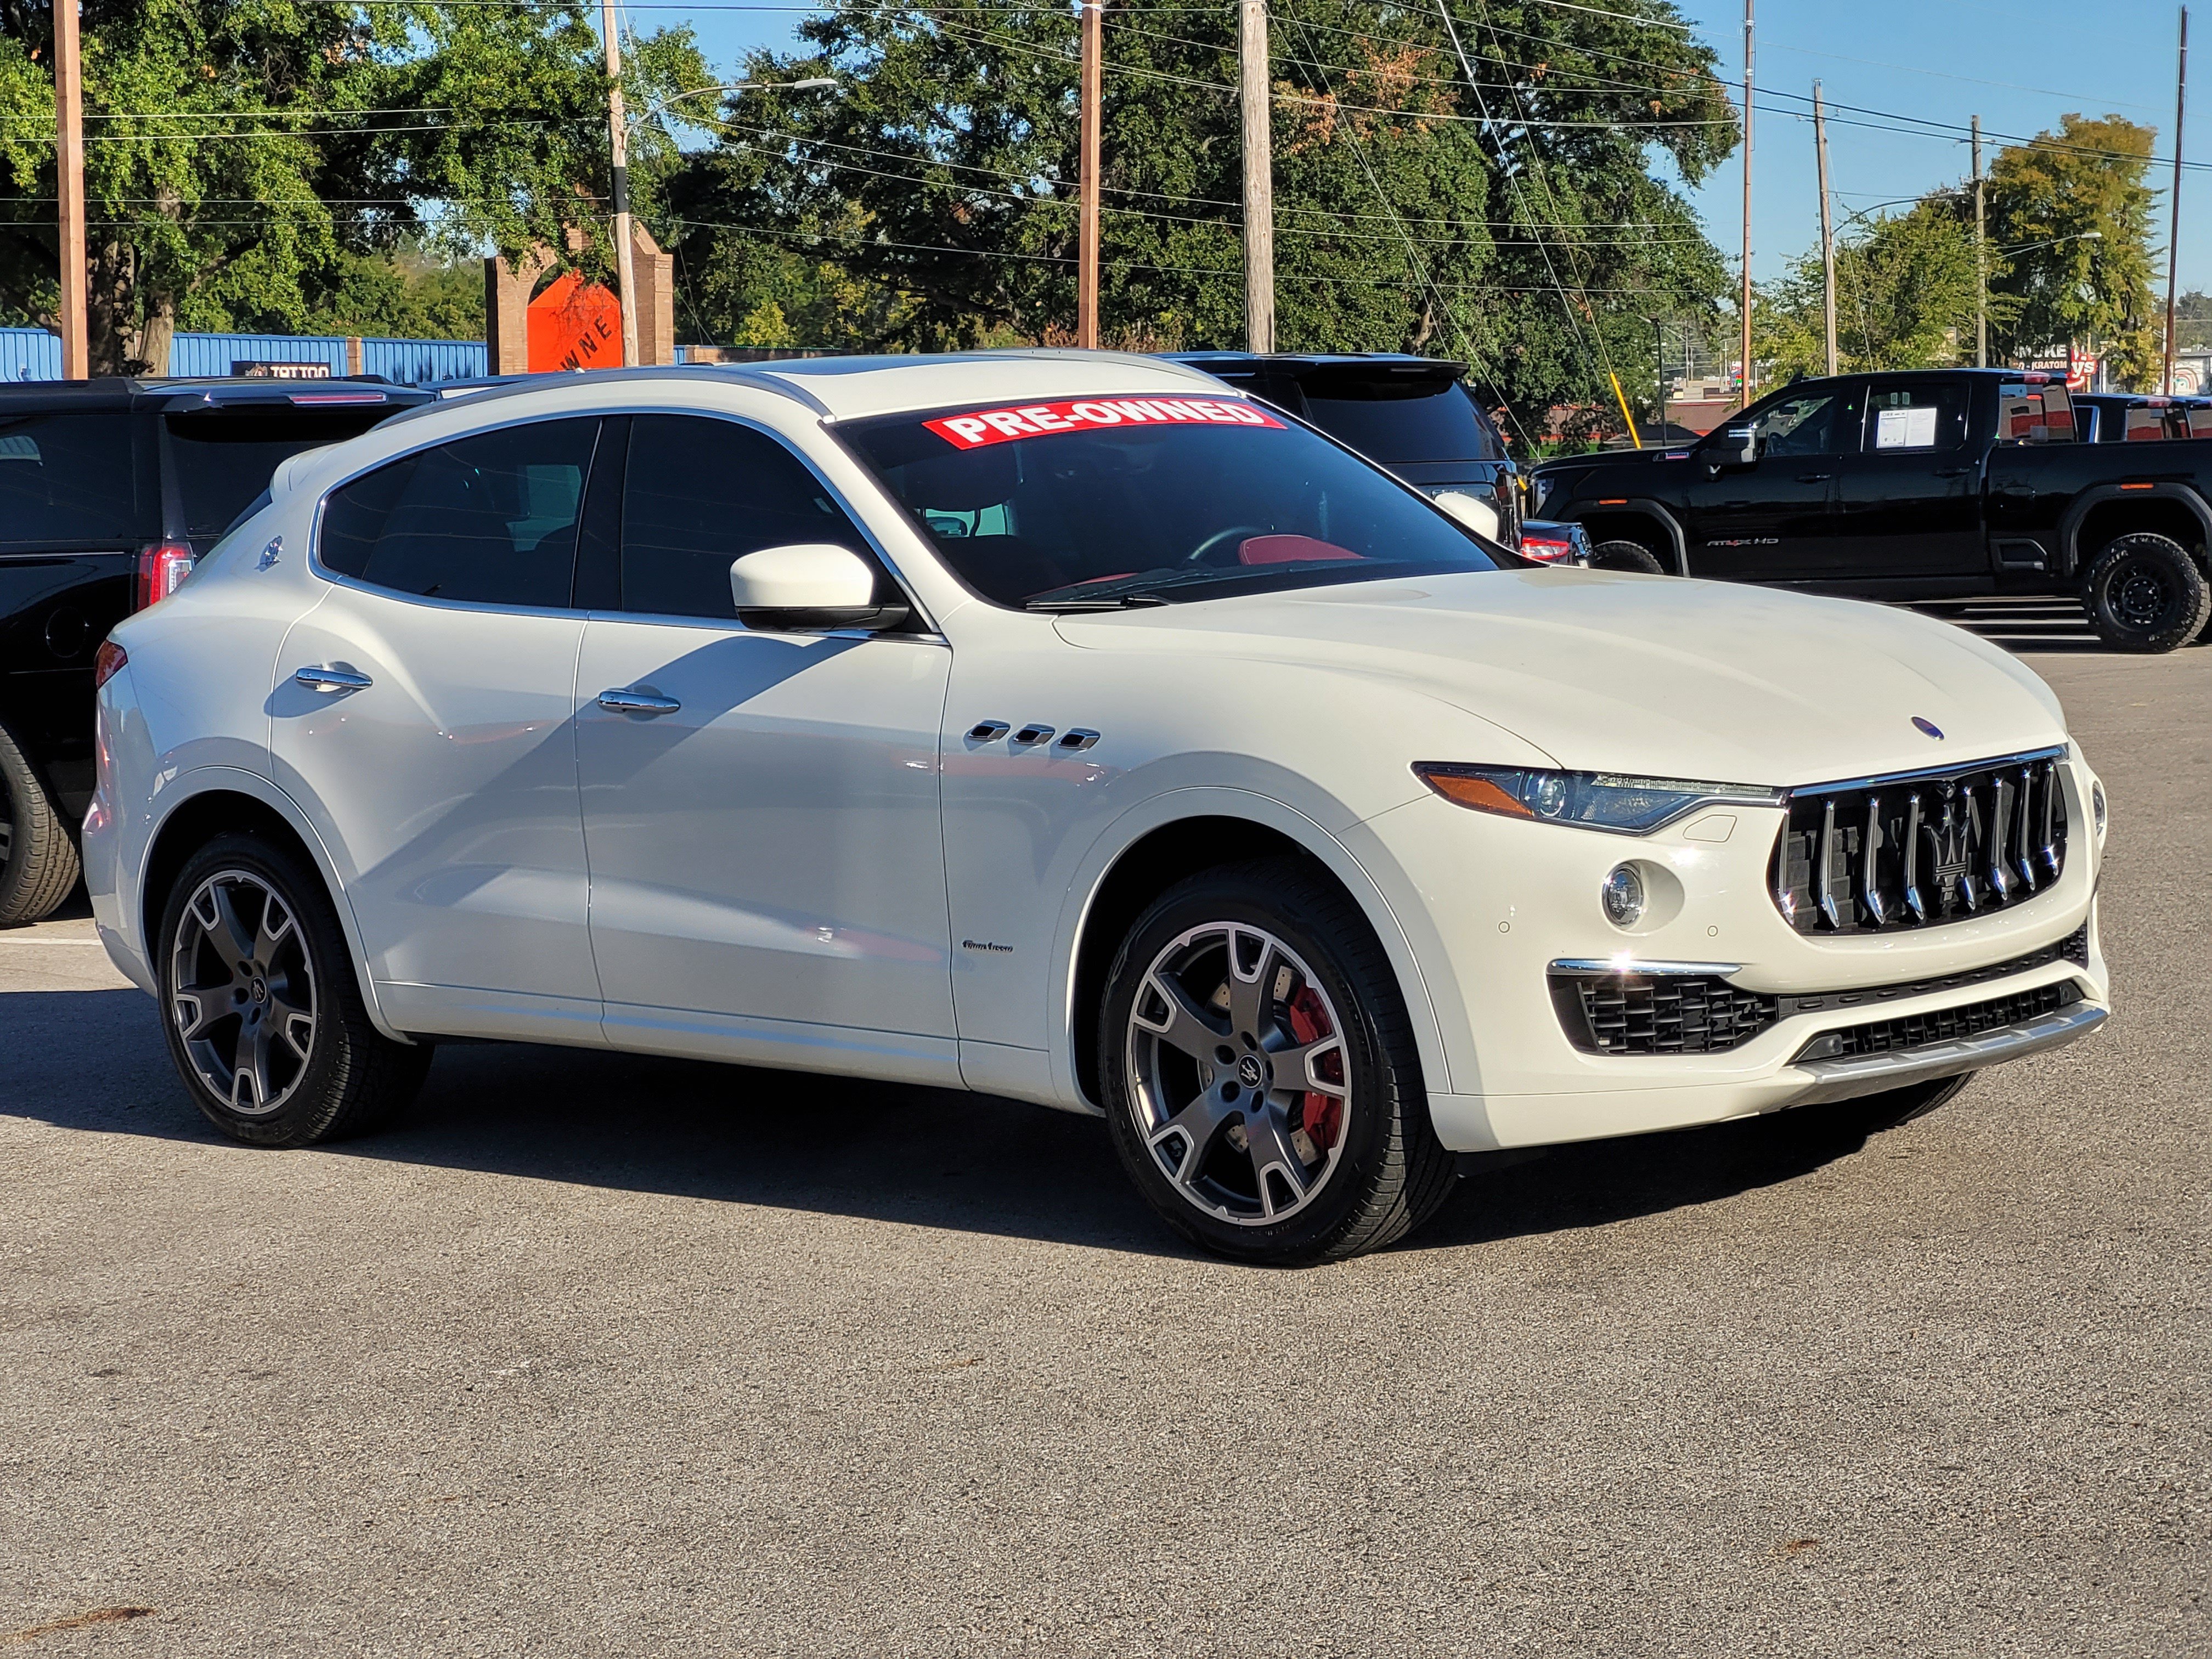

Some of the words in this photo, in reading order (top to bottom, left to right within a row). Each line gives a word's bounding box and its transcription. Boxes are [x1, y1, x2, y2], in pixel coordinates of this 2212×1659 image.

[556, 314, 612, 371] WNE
[2032, 360, 2067, 371] KRATOM
[941, 400, 1265, 443] PRE-OWNED
